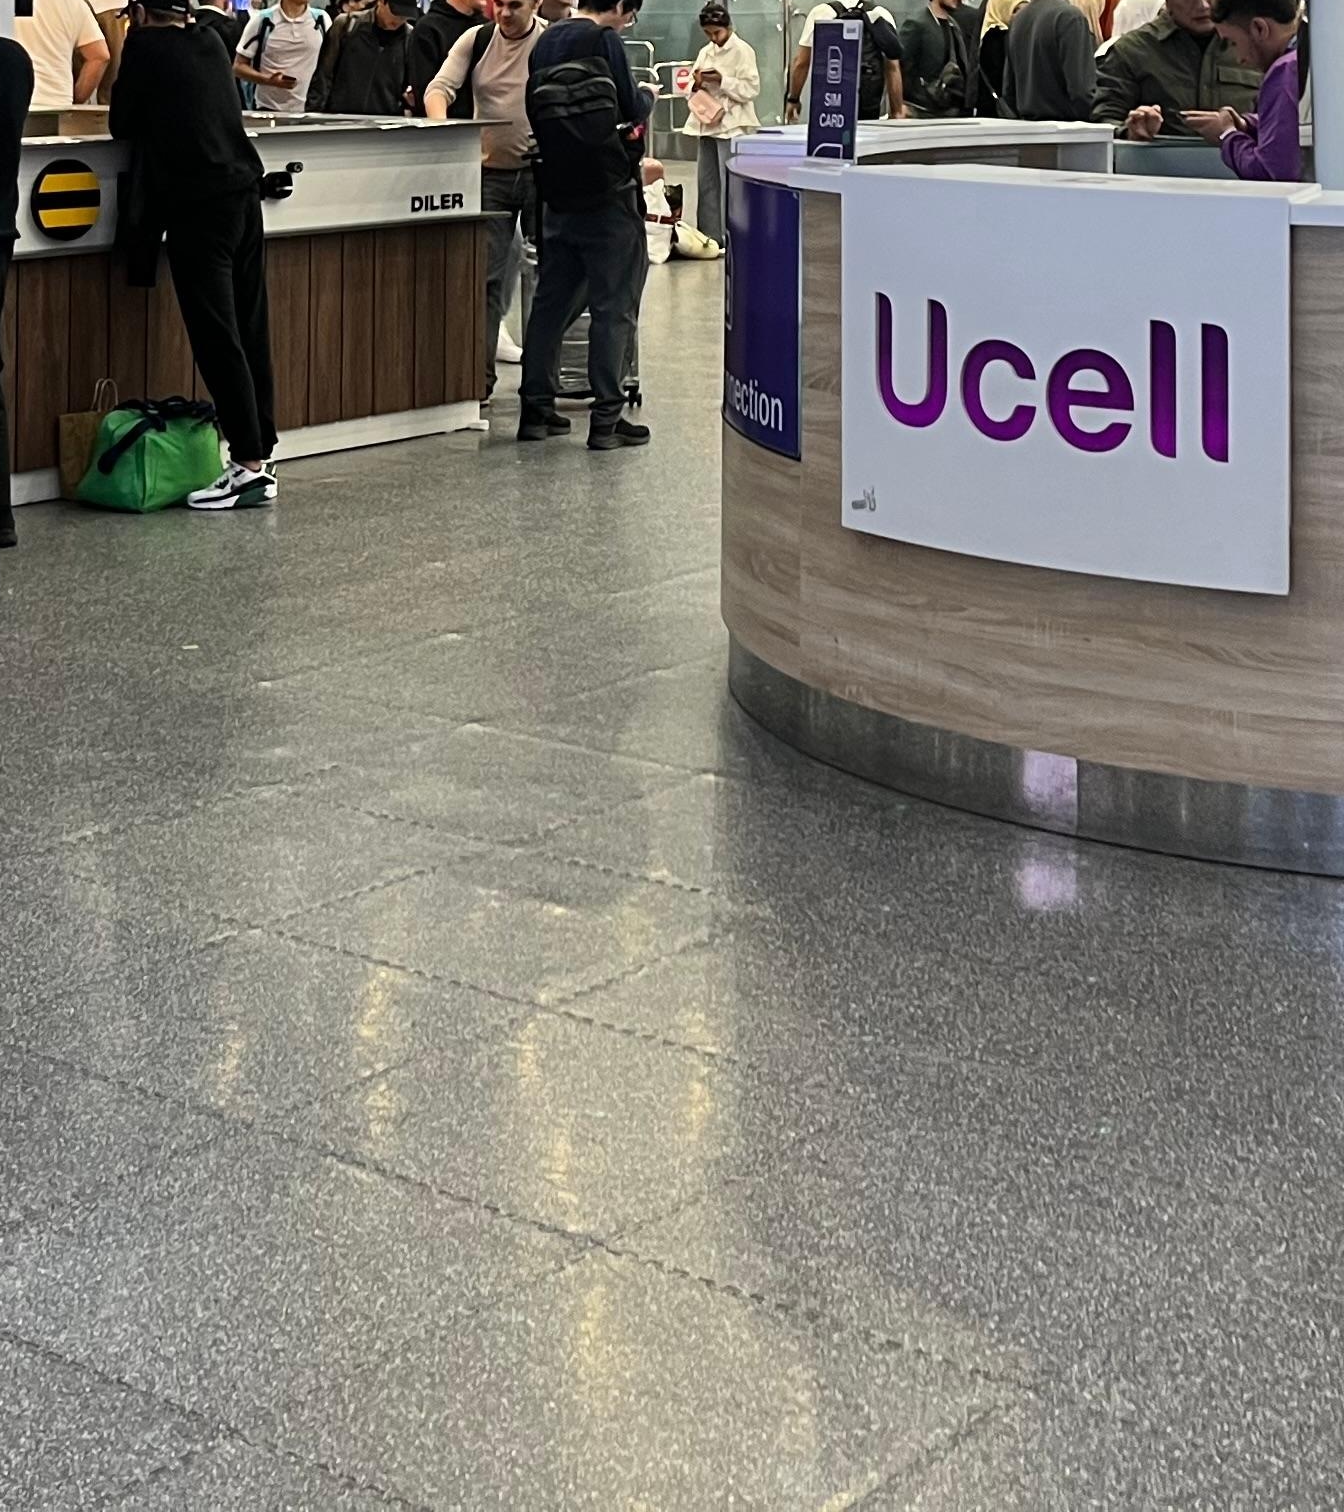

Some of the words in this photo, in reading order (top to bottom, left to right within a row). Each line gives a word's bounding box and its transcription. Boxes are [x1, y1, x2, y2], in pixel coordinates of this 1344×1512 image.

[823, 92, 842, 107] SIM
[818, 112, 845, 128] CARD
[409, 191, 465, 213] DILER
[874, 291, 1230, 464] Ucell
